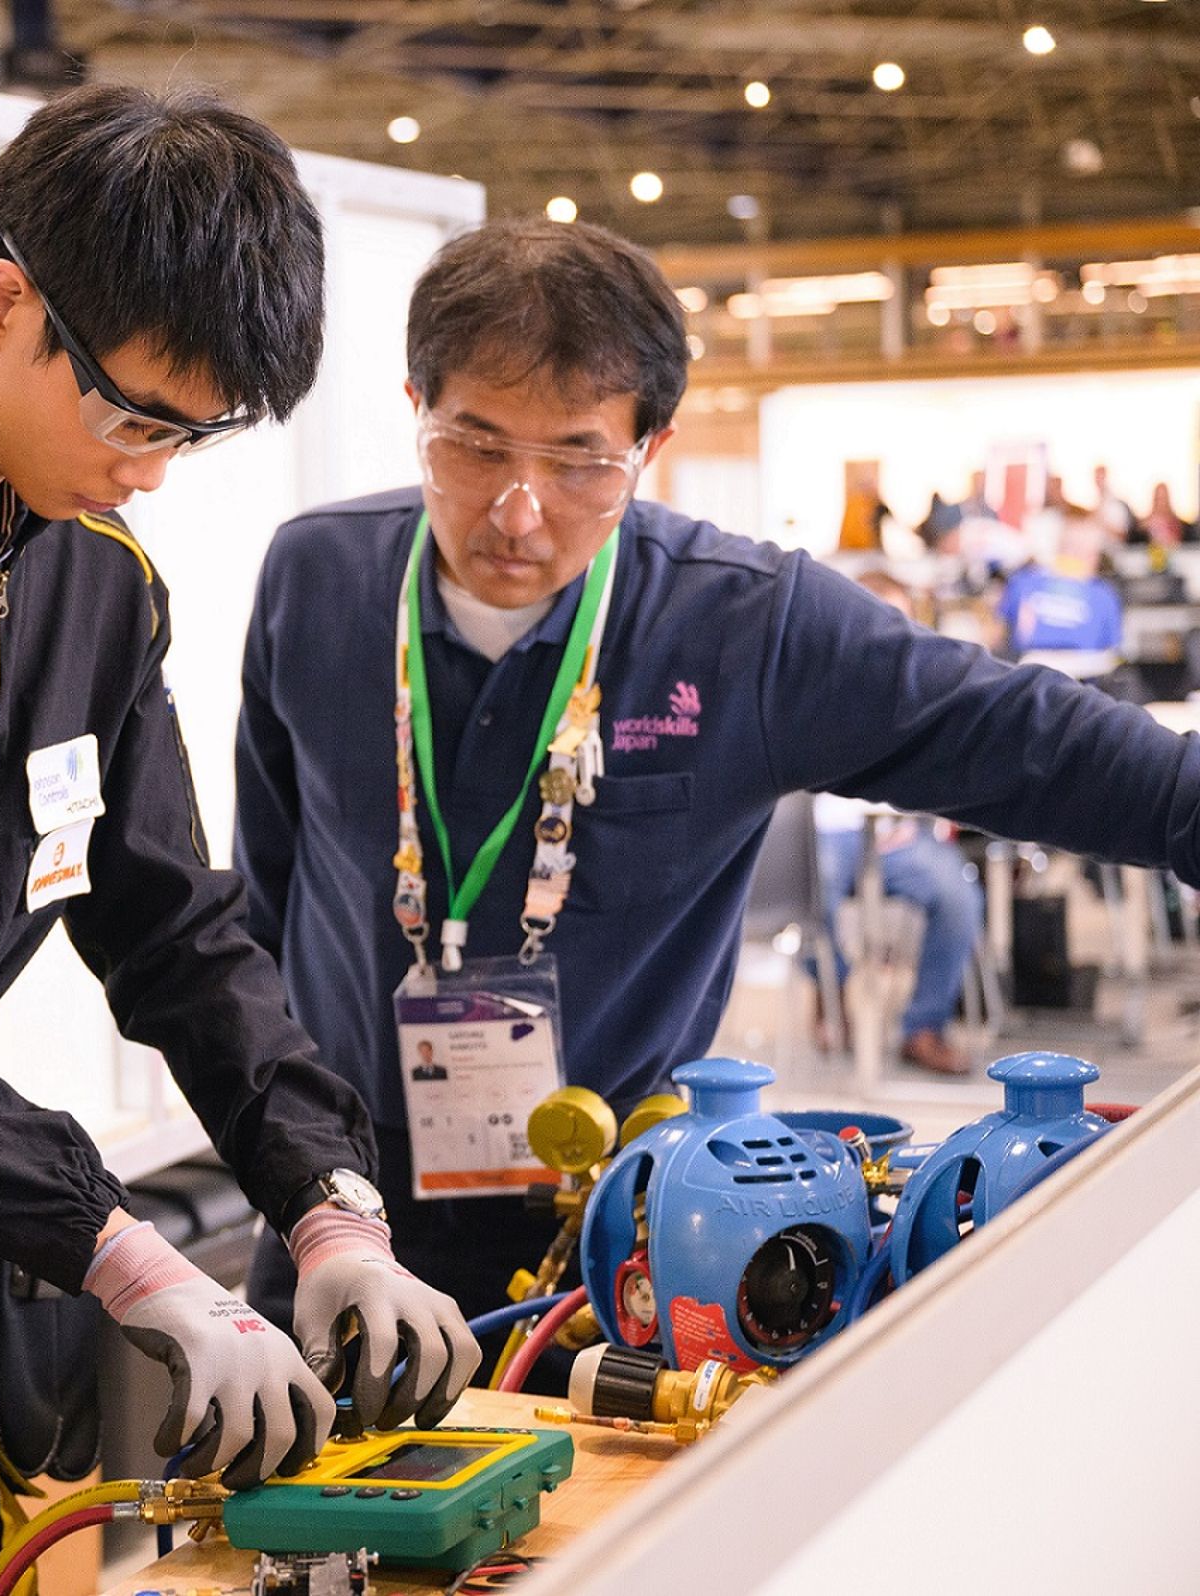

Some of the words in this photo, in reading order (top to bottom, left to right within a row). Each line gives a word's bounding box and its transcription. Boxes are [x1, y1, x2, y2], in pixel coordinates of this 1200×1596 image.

[613, 714, 699, 737] worldskills
[612, 733, 658, 754] Japan
[714, 1193, 771, 1218] AIR
[778, 1184, 856, 1218] LIQUIDE
[232, 1319, 266, 1334] 3M
